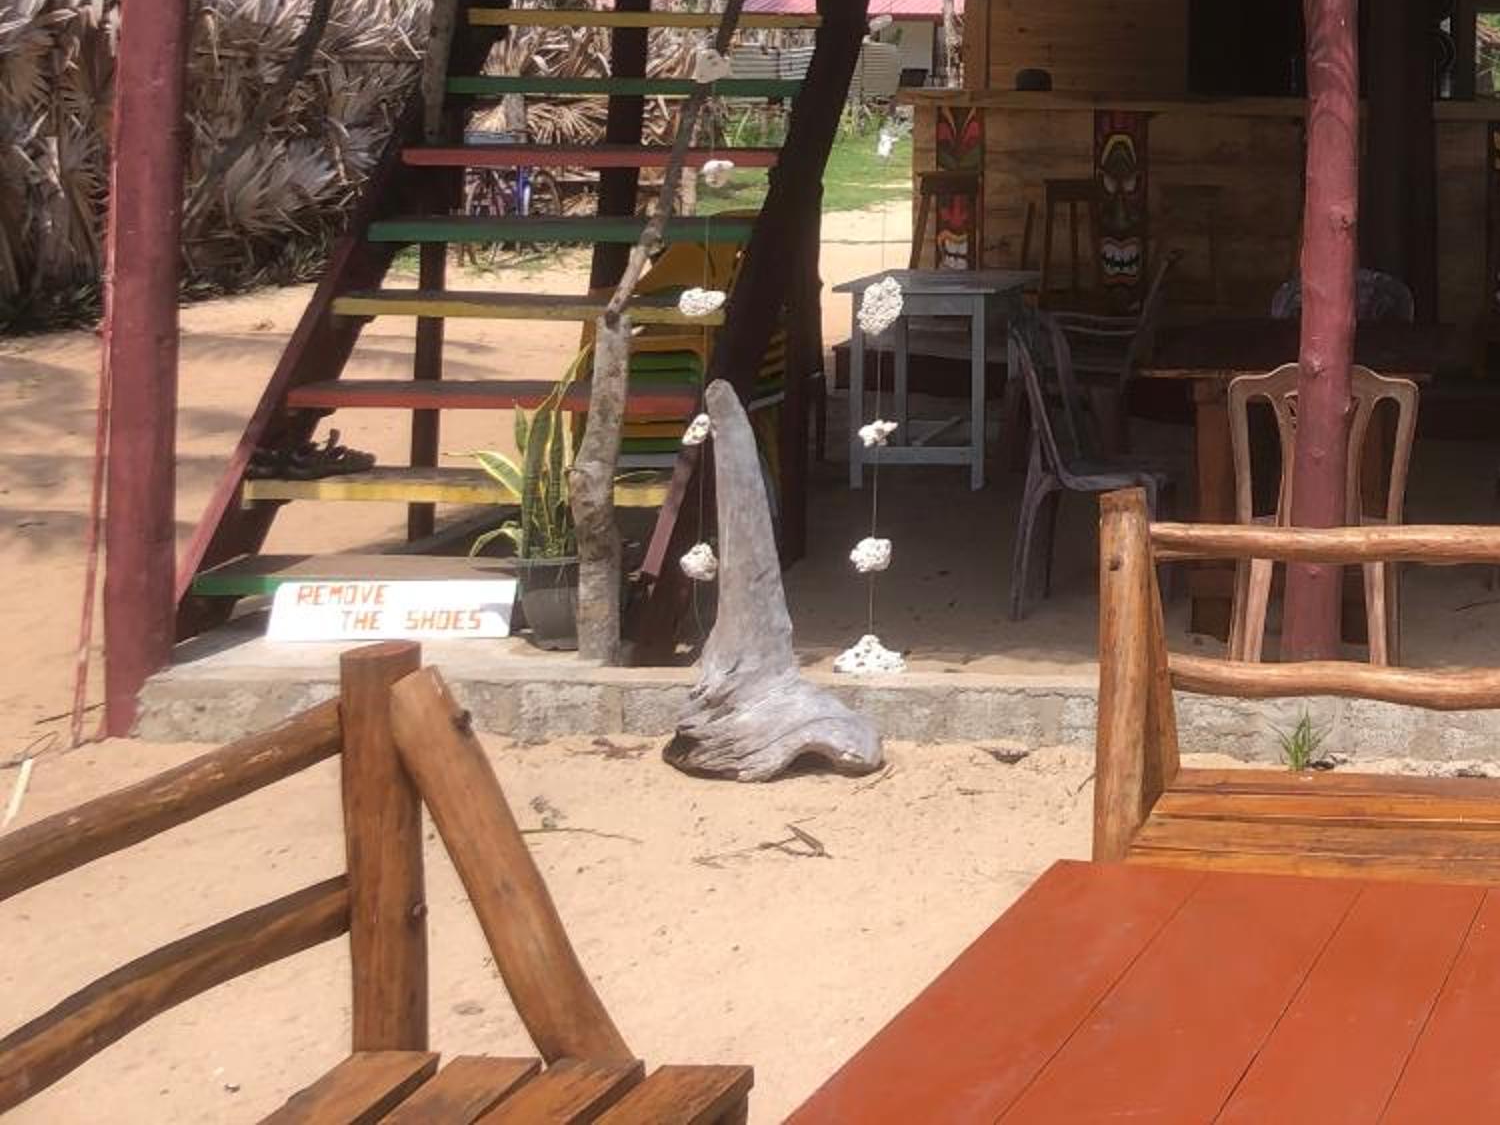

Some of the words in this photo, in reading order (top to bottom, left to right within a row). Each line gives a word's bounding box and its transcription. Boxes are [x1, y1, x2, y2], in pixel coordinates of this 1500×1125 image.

[297, 584, 388, 606] REMOVE
[343, 610, 383, 631] THE
[405, 609, 482, 631] SHOES
